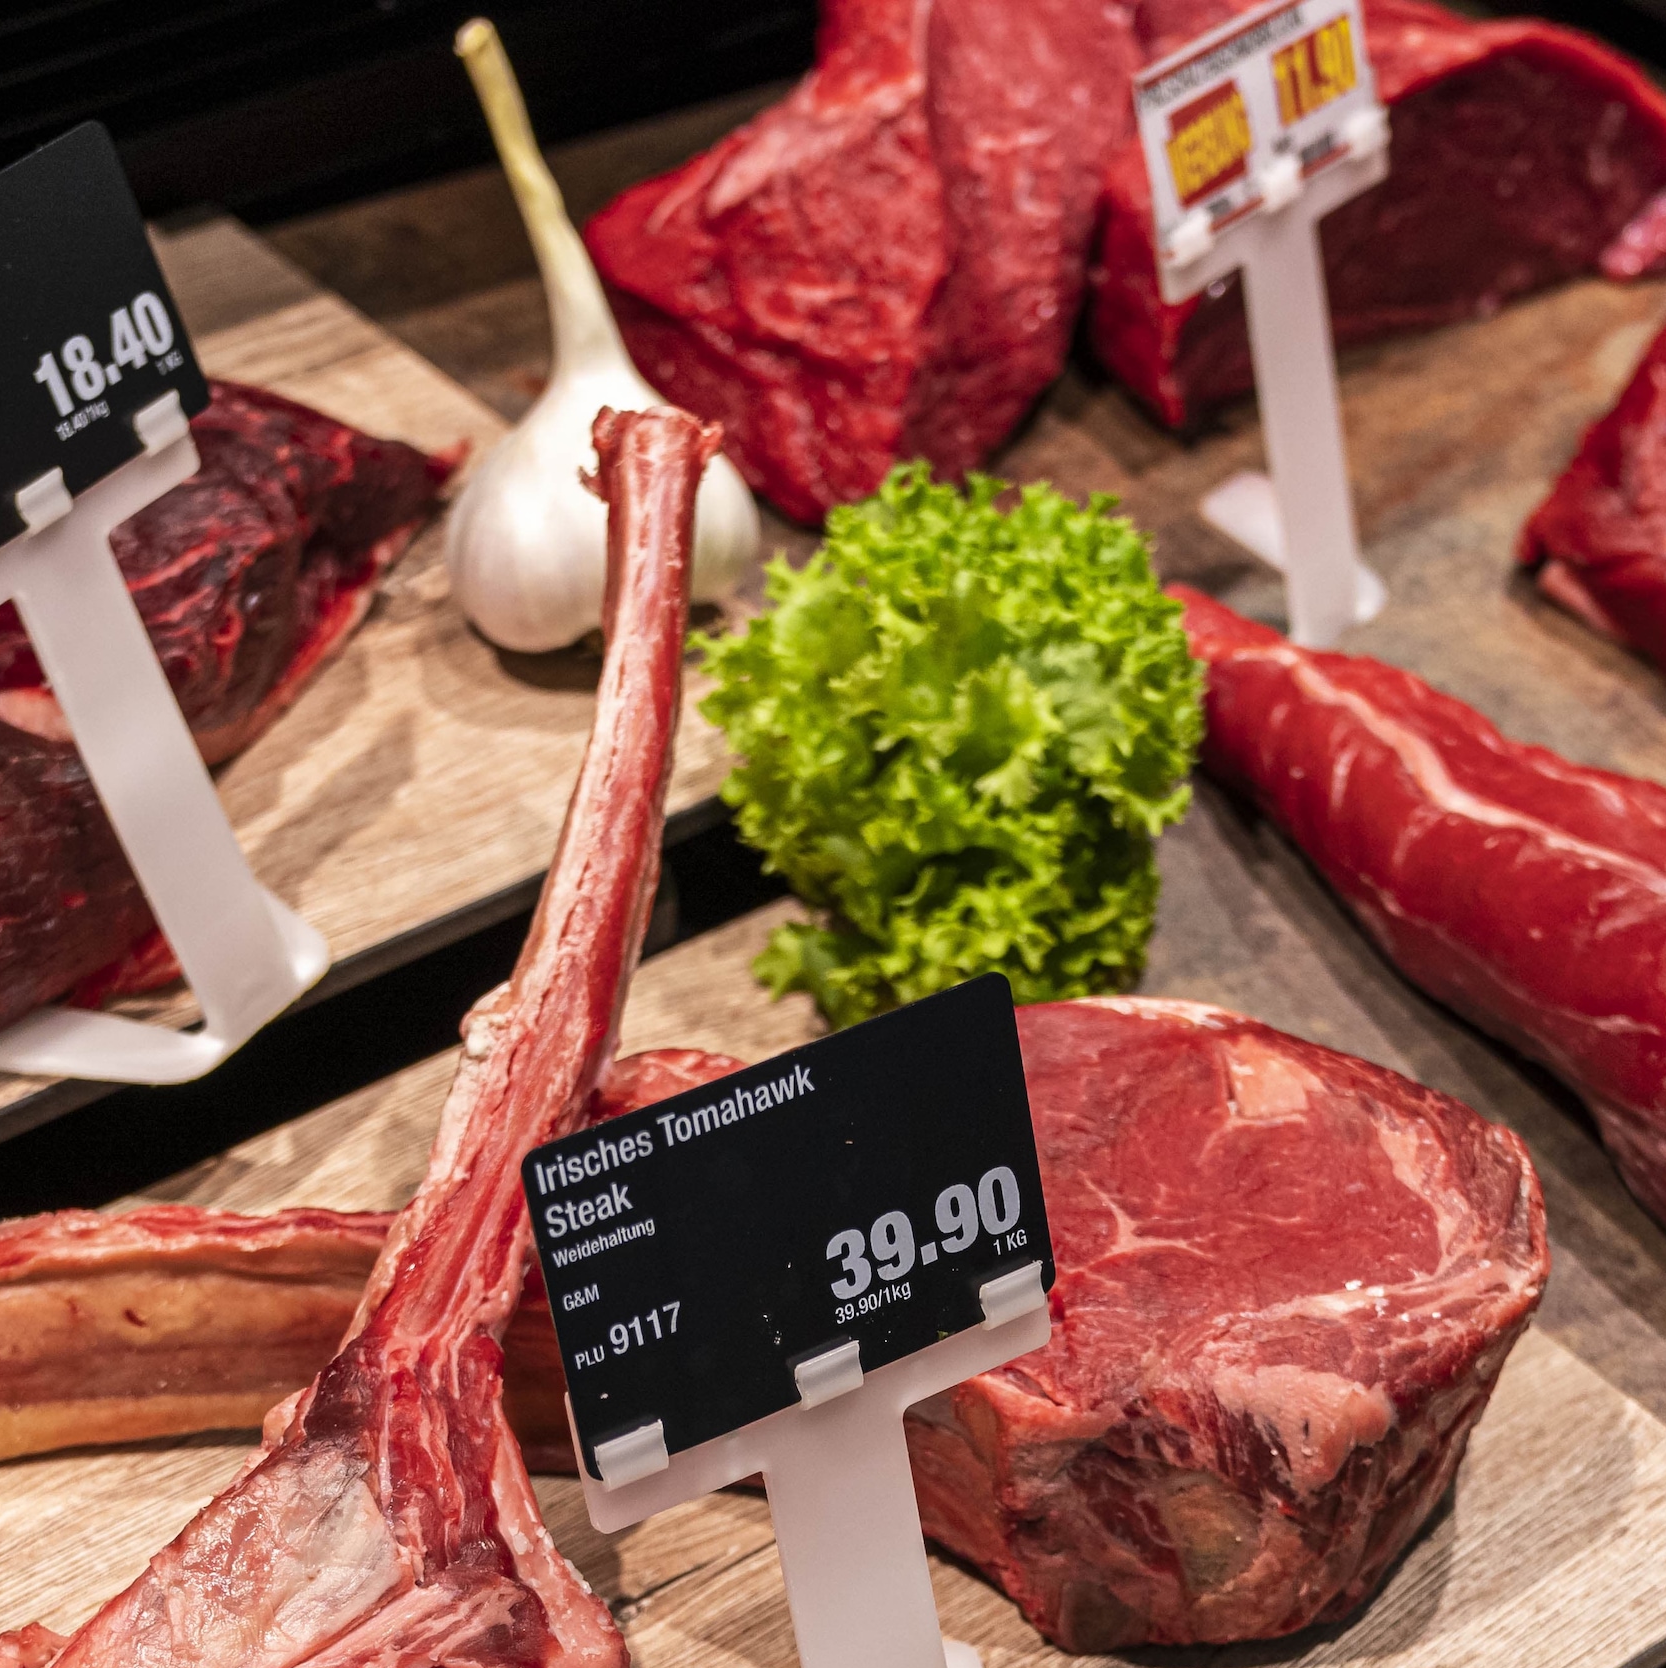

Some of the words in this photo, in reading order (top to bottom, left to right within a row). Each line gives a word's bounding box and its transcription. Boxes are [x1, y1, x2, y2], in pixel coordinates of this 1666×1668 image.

[33, 290, 174, 417] 18.40
[534, 1128, 654, 1196] Irisches
[656, 1064, 815, 1149] Tomahawk
[544, 1182, 634, 1239] Steak
[826, 1165, 1022, 1301] 39.90
[552, 1216, 656, 1270] Weidehaltung
[993, 1237, 1002, 1256] 1
[1006, 1229, 1027, 1252] KG
[562, 1283, 600, 1313] G&M
[834, 1281, 912, 1326] 39.90/1kg
[574, 1344, 605, 1371] PLU
[609, 1301, 682, 1358] 9117
